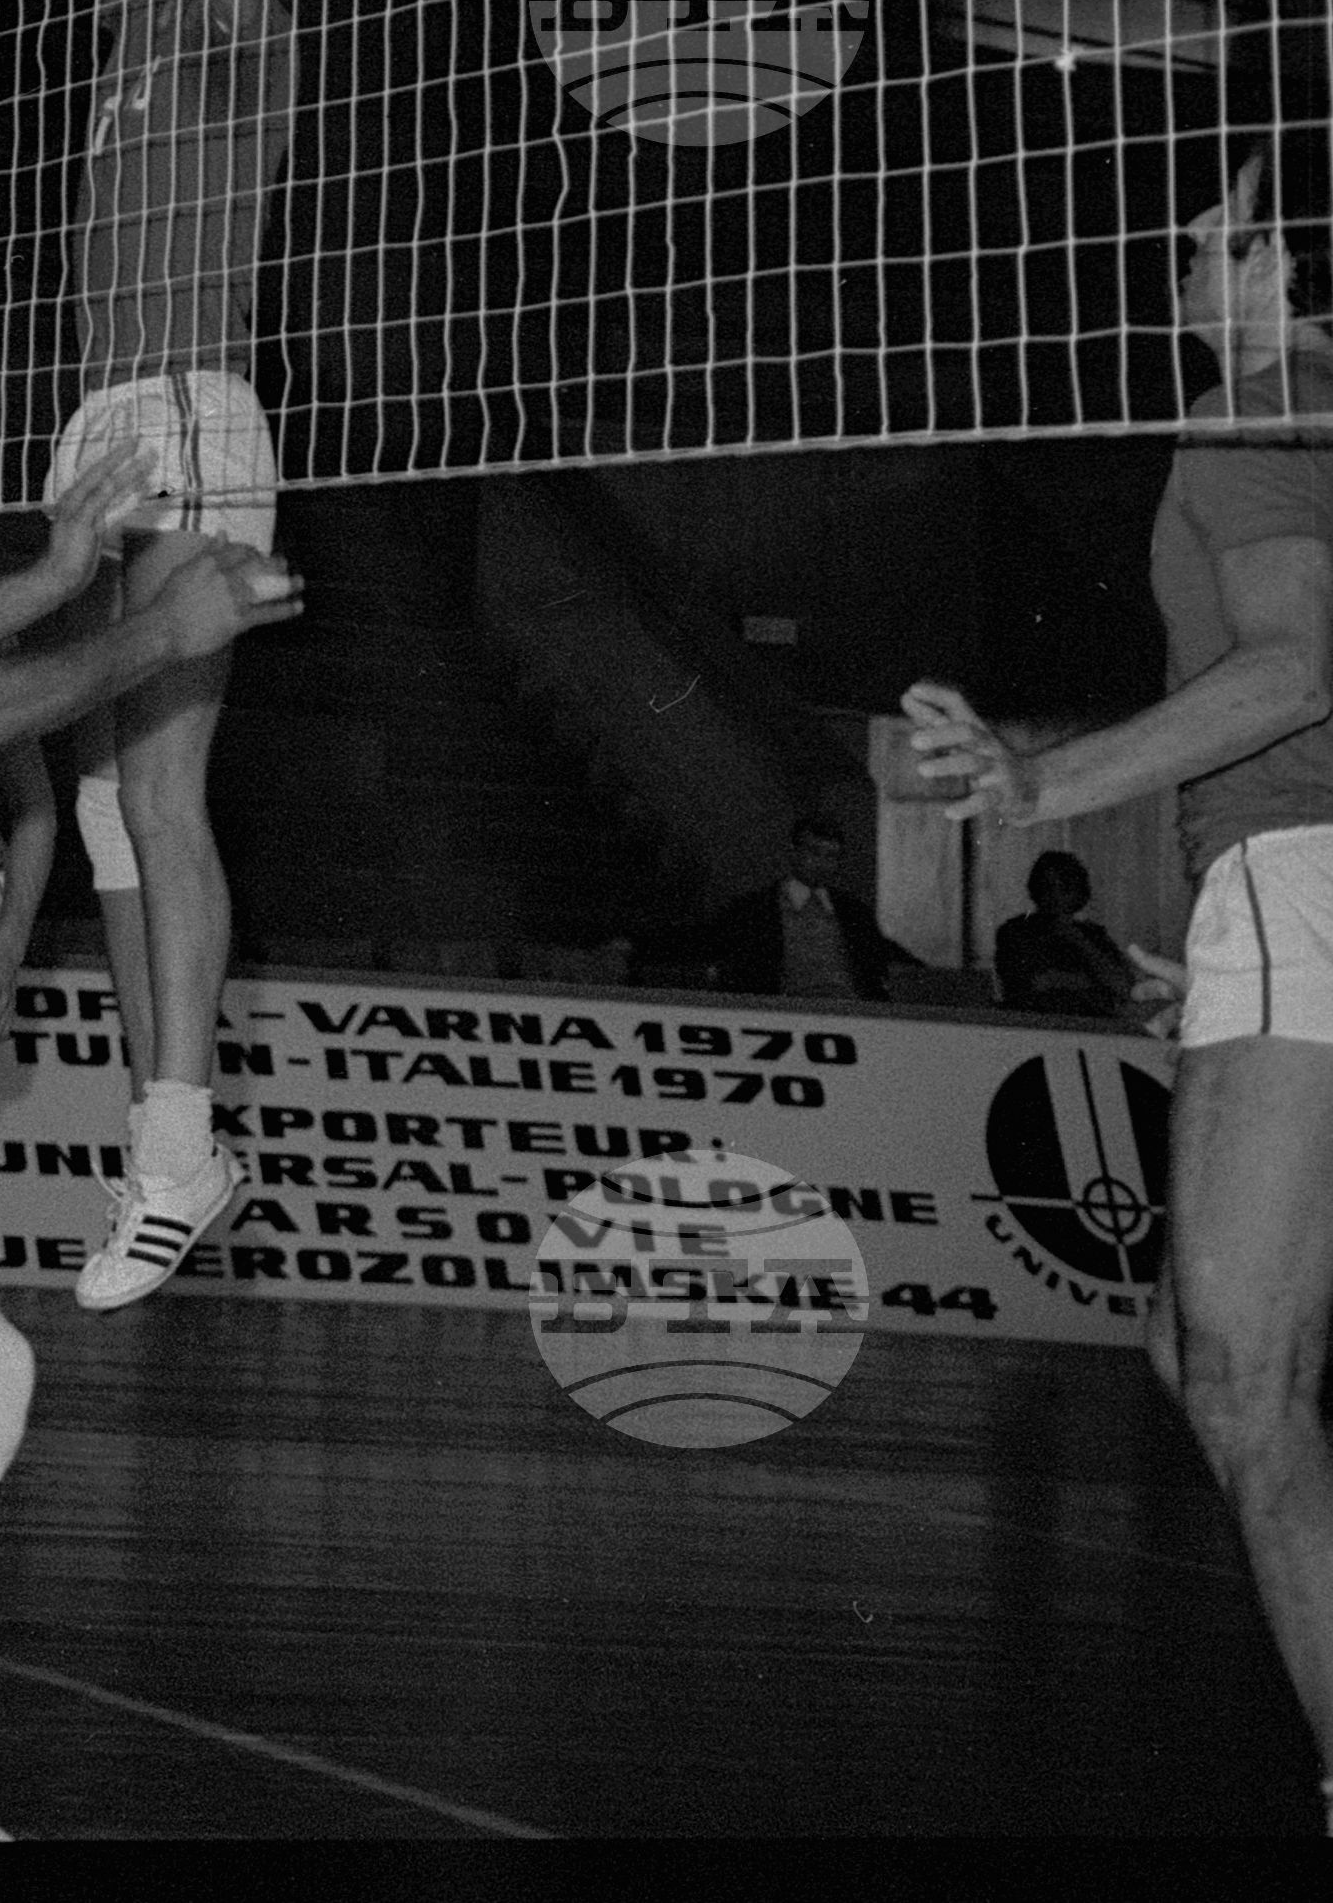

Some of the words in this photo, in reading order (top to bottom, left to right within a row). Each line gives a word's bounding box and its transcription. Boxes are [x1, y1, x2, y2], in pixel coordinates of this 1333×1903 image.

[635, 1022, 858, 1065] 1970
[611, 1065, 825, 1108] 1970
[212, 1104, 727, 1163] XPORTEUR:
[231, 1199, 730, 1257] ARSOVIE
[175, 1244, 860, 1310] EROZOLIMSKIE
[882, 1284, 998, 1320] 44
[986, 1214, 1138, 1318] UNIVE
